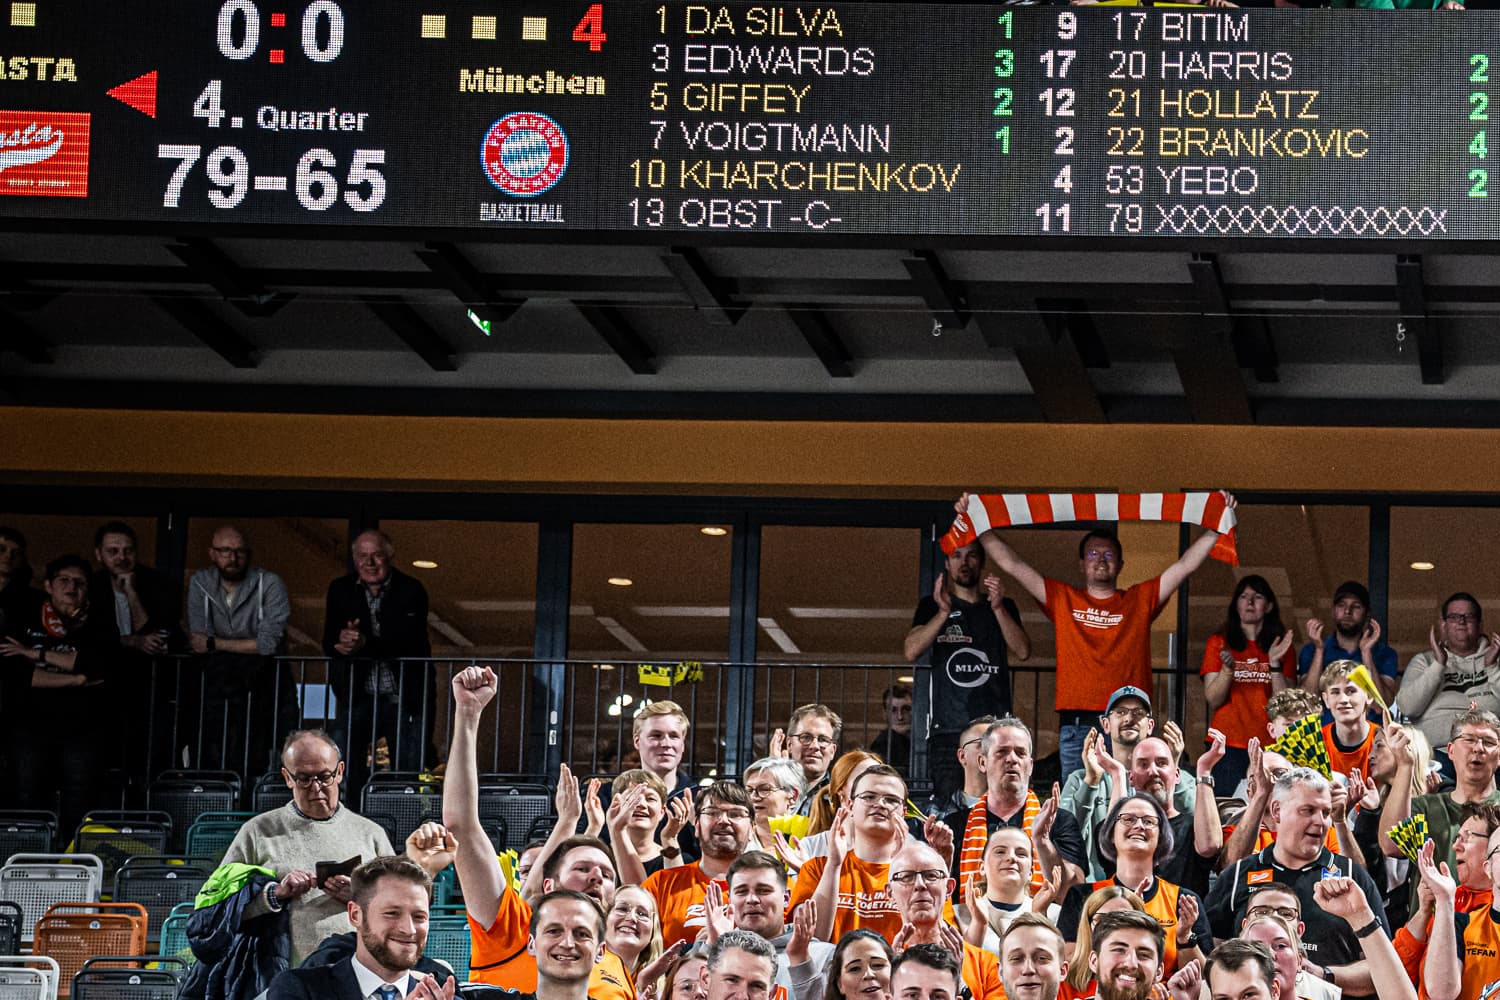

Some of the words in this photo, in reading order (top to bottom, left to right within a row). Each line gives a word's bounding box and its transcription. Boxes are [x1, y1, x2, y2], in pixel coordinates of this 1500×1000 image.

[572, 3, 607, 51] 4
[656, 5, 667, 34] 1
[685, 6, 735, 36] DA
[746, 7, 843, 37] SILVA
[997, 11, 1013, 39] 1
[1057, 11, 1078, 40] 9
[1112, 12, 1147, 41] 17
[1162, 13, 1250, 43] BITIM
[652, 44, 671, 73] 3
[684, 44, 876, 76] EDWARDS
[994, 49, 1014, 78] 3
[1039, 49, 1077, 79] 17
[1108, 51, 1146, 80] 20
[1161, 51, 1293, 81] HARRIS
[1469, 53, 1489, 83] 2
[459, 67, 606, 95] München
[192, 79, 243, 129] 4.
[256, 105, 370, 131] Quarter
[650, 82, 669, 111] 5
[683, 83, 811, 114] GIFFEY
[993, 87, 1013, 117] 2
[1038, 88, 1076, 118] 12
[1108, 88, 1143, 118] 21
[1159, 88, 1319, 120] HOLLATZ
[1468, 91, 1489, 121] 2
[650, 121, 668, 150] 7
[679, 121, 891, 154] VOIGTMANN
[995, 125, 1012, 154] 1
[1055, 126, 1075, 156] 2
[1106, 127, 1145, 157] 22
[1157, 127, 1370, 159] BRANKOVIC
[1467, 130, 1488, 159] 4
[157, 144, 387, 212] 79-65
[630, 159, 667, 188] 10
[679, 160, 962, 193] KHARCHENKOV
[1053, 164, 1074, 194] 4
[1105, 165, 1144, 195] 53
[1156, 166, 1260, 197] YEBO
[1467, 169, 1489, 198] 2
[629, 198, 665, 227] 13
[678, 199, 782, 230] OBST
[789, 200, 843, 230] -C-
[1035, 203, 1071, 233] 11
[1104, 203, 1143, 233] 79
[955, 663, 1000, 674] MIAVIT
[1466, 947, 1496, 958] TEFAN
